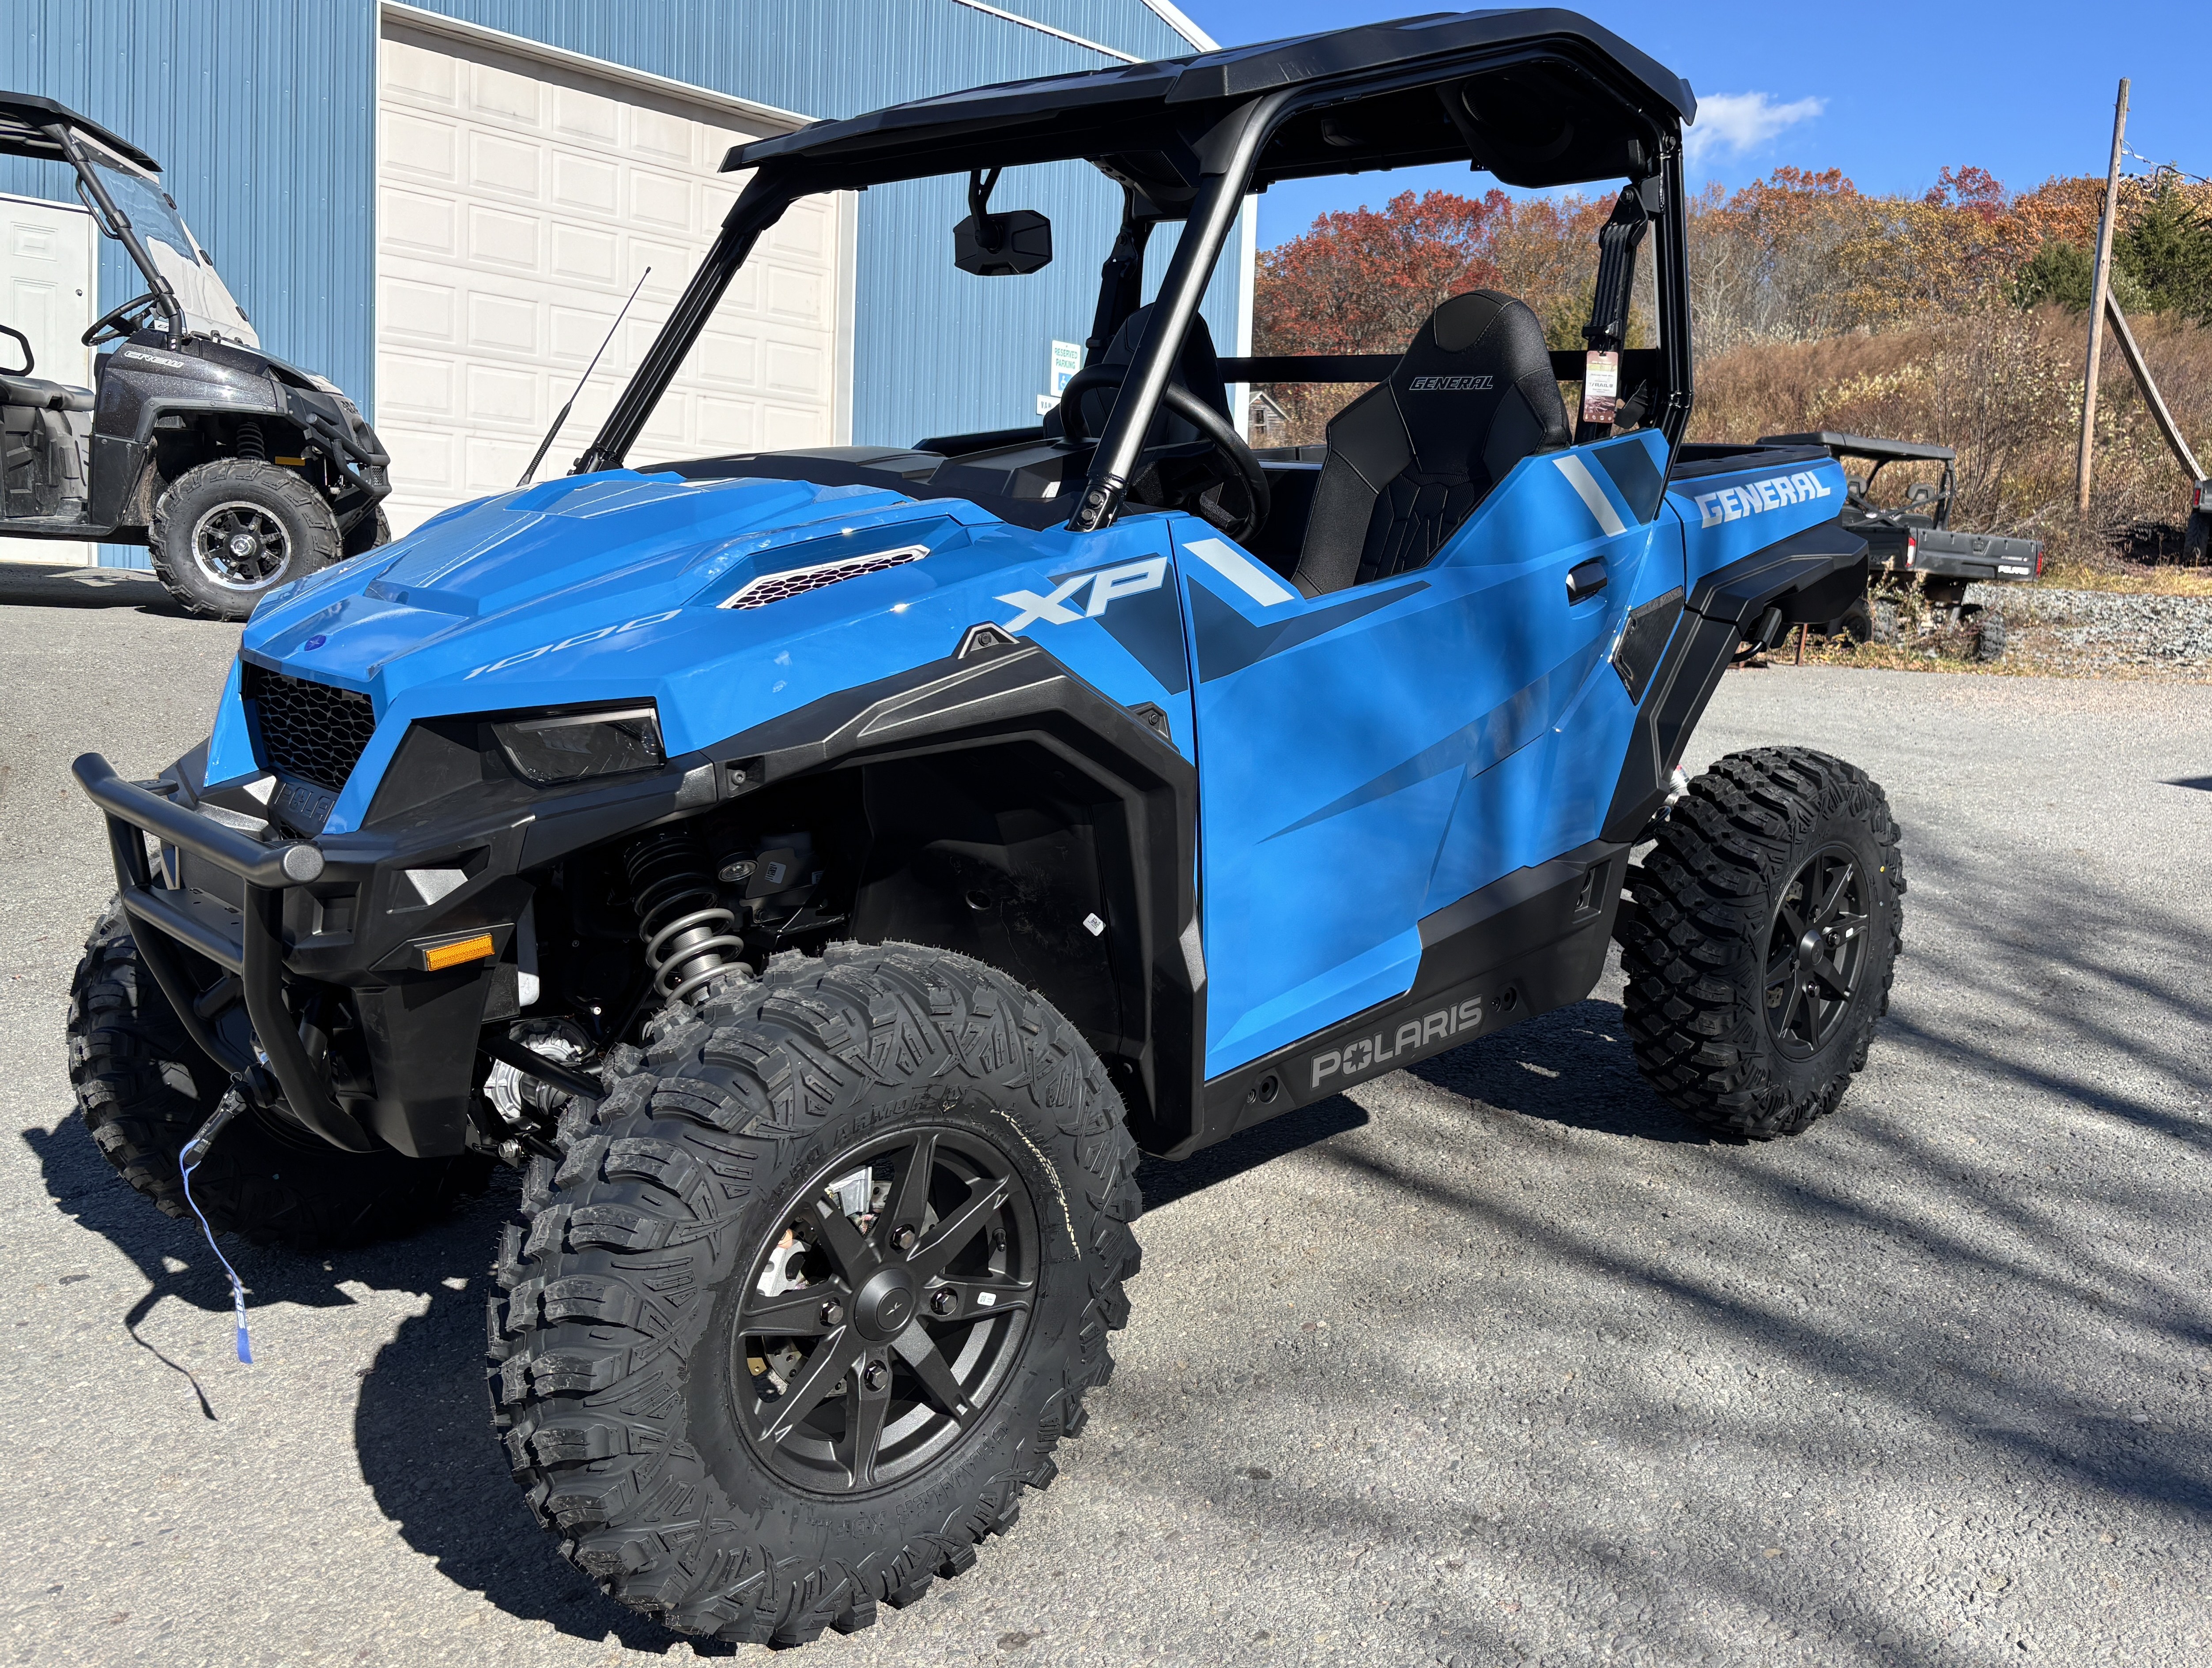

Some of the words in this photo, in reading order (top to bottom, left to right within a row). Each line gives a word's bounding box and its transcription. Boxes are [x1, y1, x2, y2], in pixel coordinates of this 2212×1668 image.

[124, 350, 184, 368] CREW
[1054, 347, 1078, 359] RESERVED
[1056, 358, 1076, 369] PARKING
[1409, 376, 1494, 391] GENERAL
[1694, 471, 1831, 529] GENERAL
[992, 556, 1168, 633] XP
[463, 609, 683, 680] 1000
[1311, 995, 1483, 1088] POLARIS
